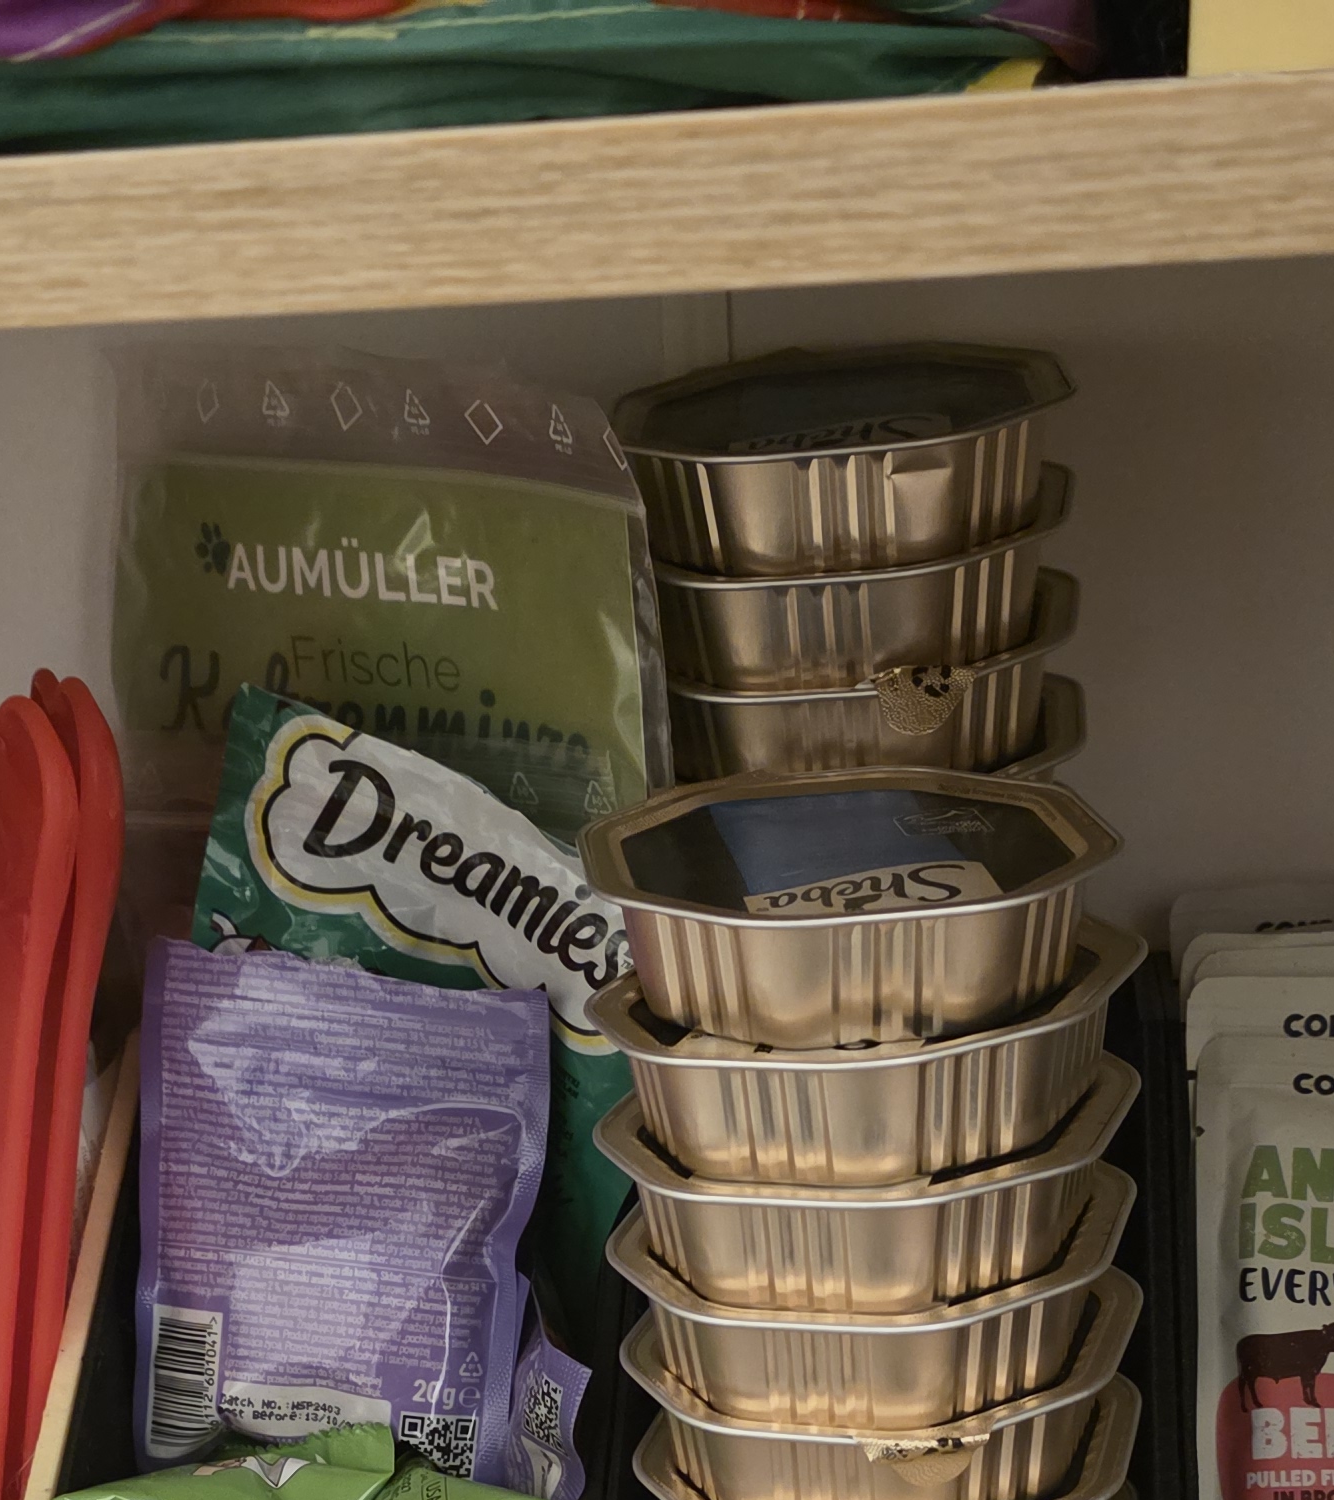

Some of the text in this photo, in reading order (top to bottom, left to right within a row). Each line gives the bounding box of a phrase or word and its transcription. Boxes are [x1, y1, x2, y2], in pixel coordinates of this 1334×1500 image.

[227, 537, 500, 612] AUMÜLLER
[288, 633, 464, 693] Frische
[302, 758, 633, 992] Dreamies
[764, 861, 967, 909] Sheba
[1245, 1469, 1316, 1491] PULLED
